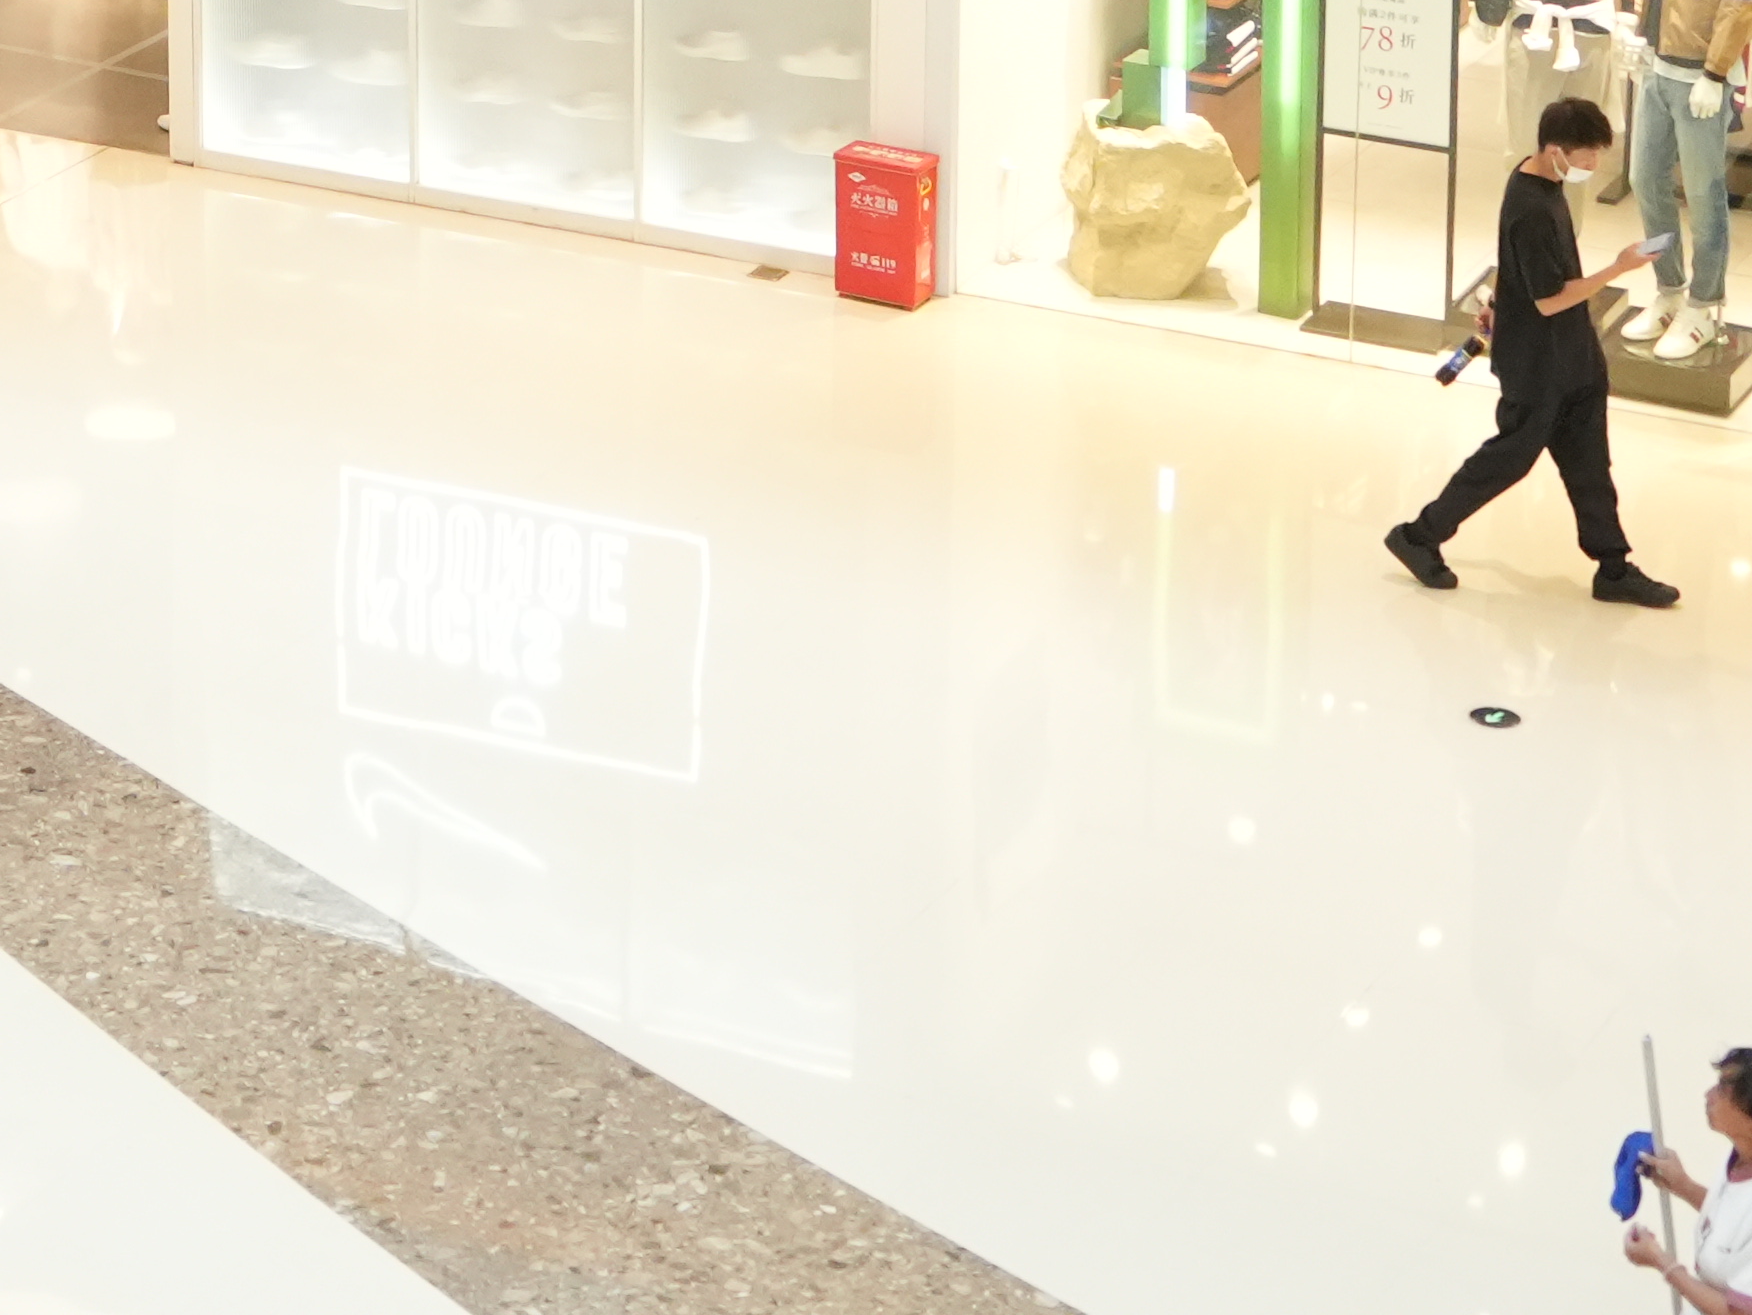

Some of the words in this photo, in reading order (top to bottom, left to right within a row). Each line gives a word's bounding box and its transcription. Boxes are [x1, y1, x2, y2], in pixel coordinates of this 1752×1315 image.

[1361, 26, 1393, 51] 78
[1400, 32, 1416, 49] 折
[1377, 85, 1393, 110] 9
[1399, 87, 1414, 104] 折
